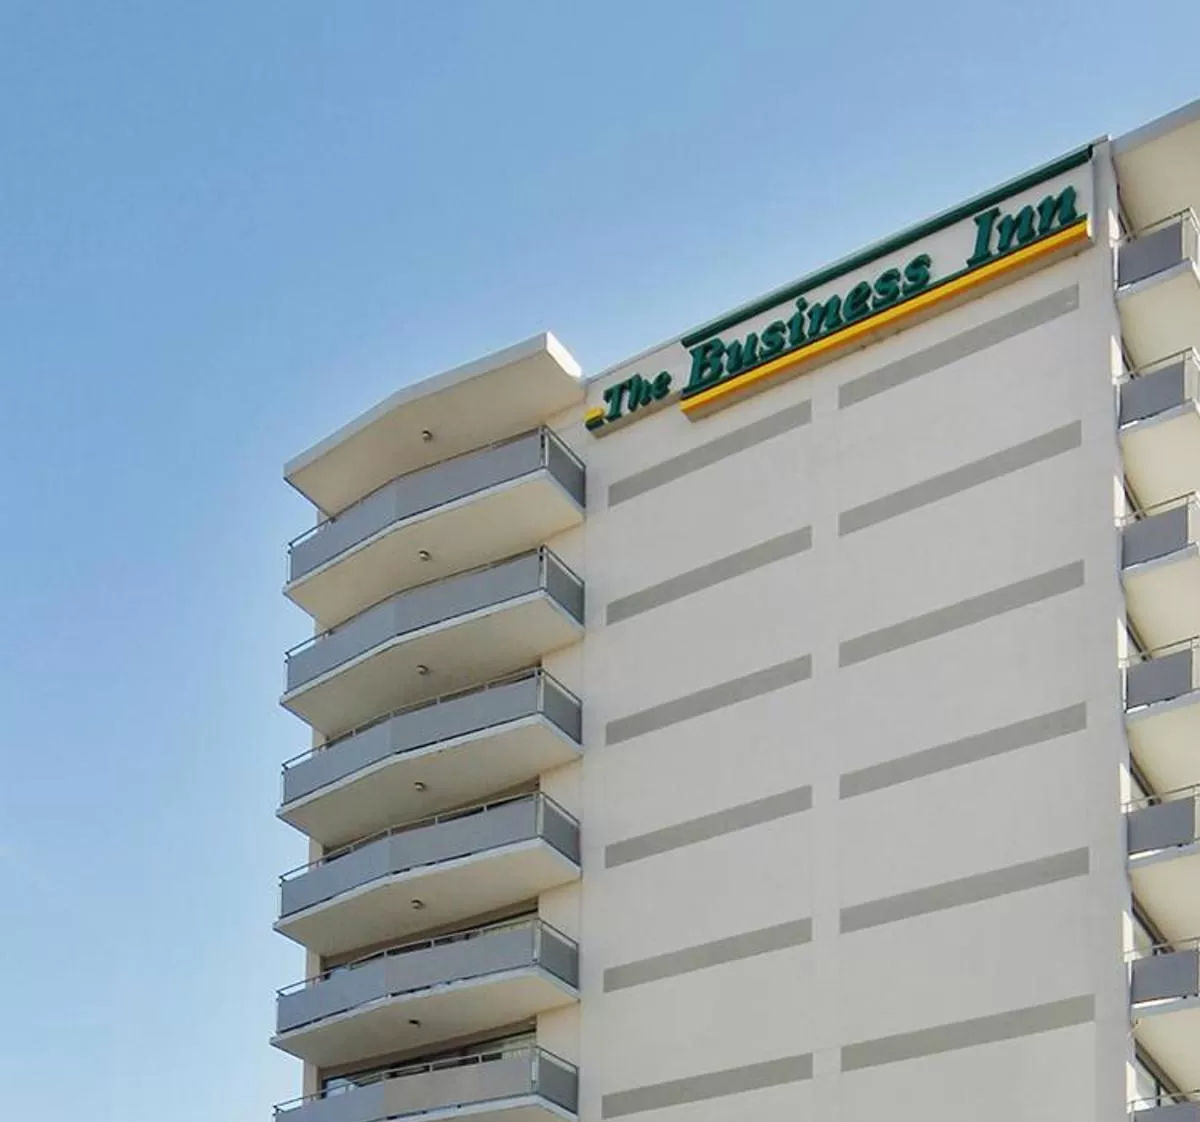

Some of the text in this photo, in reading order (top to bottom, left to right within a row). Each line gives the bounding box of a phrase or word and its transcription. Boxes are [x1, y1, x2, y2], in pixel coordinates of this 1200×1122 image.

[603, 185, 1078, 422] The Business Inn
